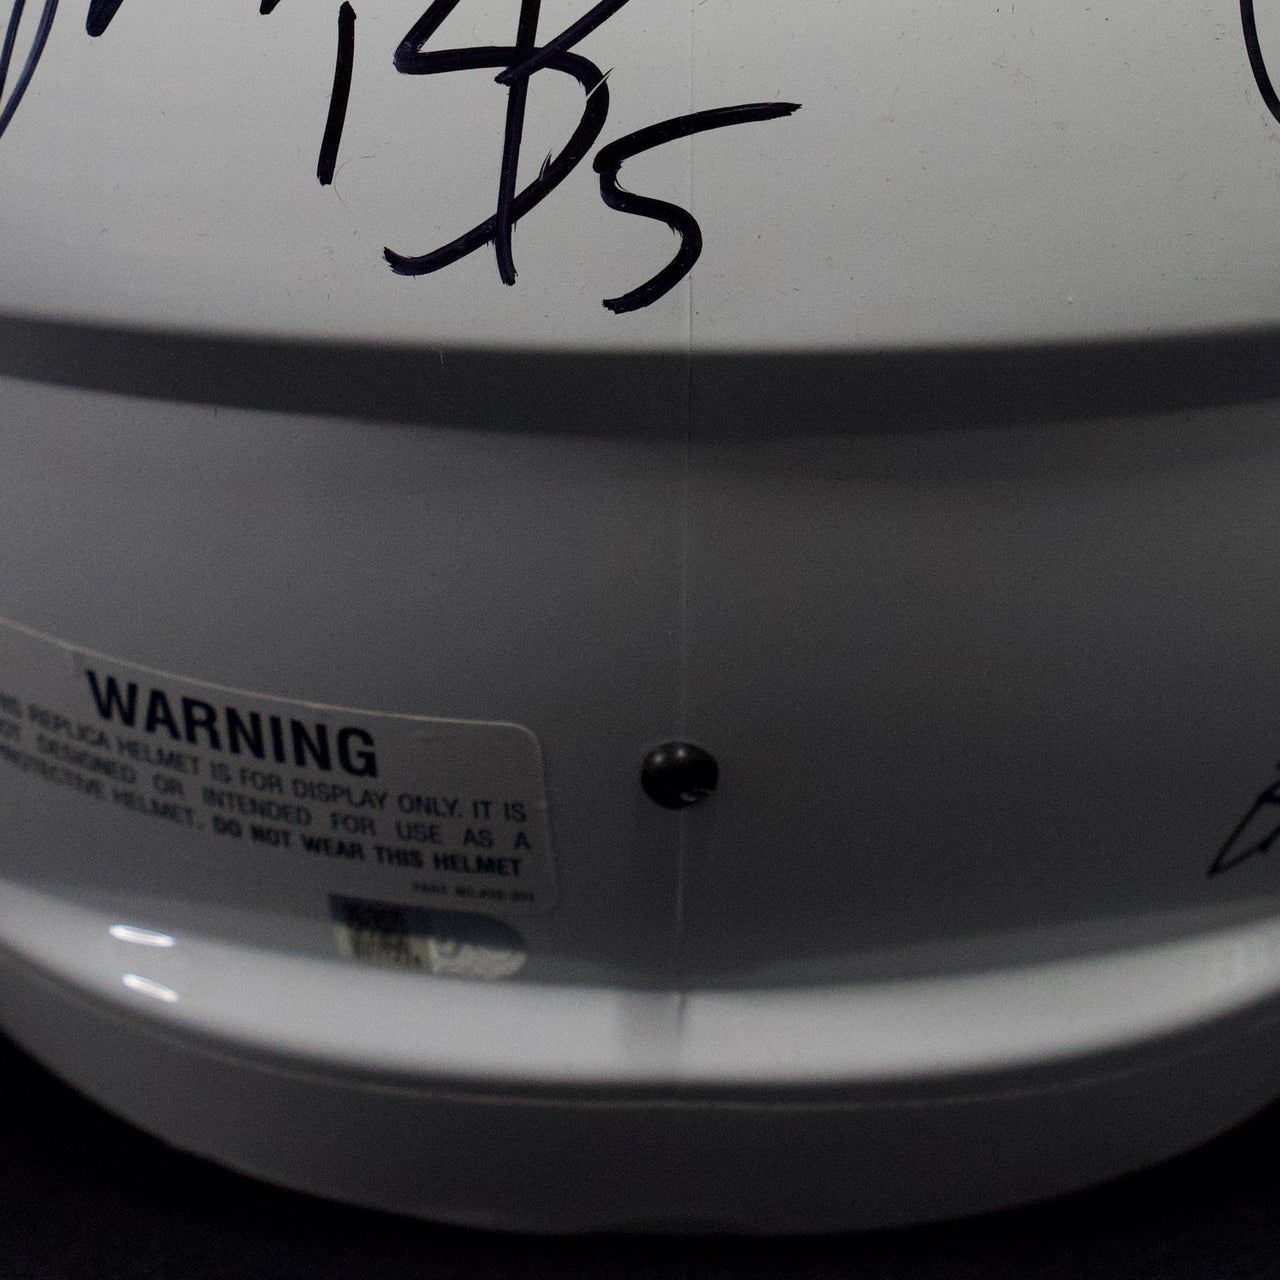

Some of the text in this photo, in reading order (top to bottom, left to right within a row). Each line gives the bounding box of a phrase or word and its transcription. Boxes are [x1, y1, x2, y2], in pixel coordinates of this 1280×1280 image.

[27, 703, 110, 748] REPLICA
[118, 736, 199, 775] HELMET
[210, 761, 233, 784] IS
[238, 767, 284, 794] FOR
[292, 776, 389, 811] DISPLAY
[472, 798, 492, 819] IT
[504, 800, 528, 823] IS
[85, 668, 378, 778] WARNING
[35, 731, 138, 785] DESIGNED
[151, 772, 184, 800] OR
[202, 784, 313, 827] INTENDED
[331, 811, 376, 837] FOR
[395, 821, 442, 845] USE
[462, 826, 493, 849] AS
[514, 830, 532, 851] A
[213, 814, 243, 839] DO
[250, 823, 291, 848] NOT
[300, 832, 364, 860] WEAR
[375, 845, 424, 869] THIS
[432, 851, 522, 876] HELMET
